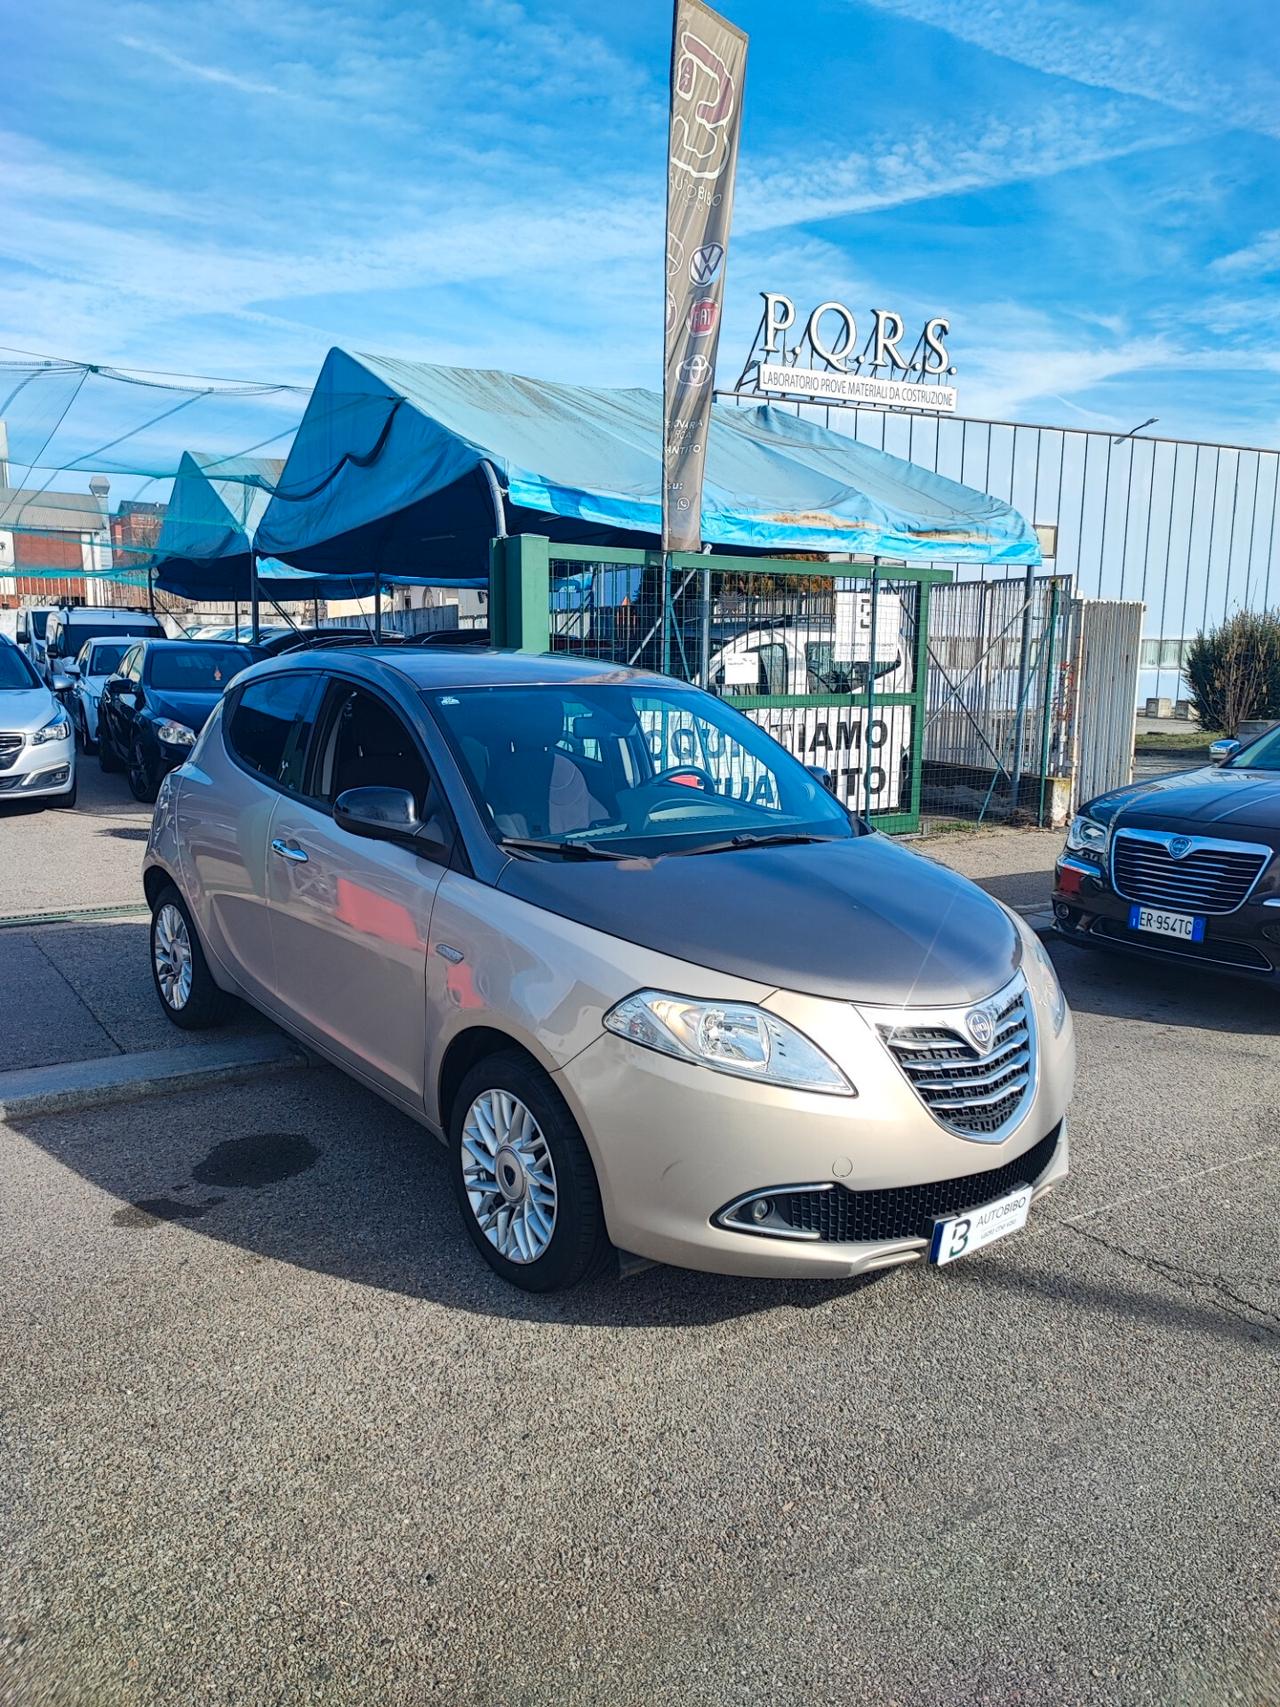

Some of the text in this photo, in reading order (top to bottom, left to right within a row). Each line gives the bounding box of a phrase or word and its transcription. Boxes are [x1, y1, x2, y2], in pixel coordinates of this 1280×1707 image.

[763, 371, 953, 407] LABORATORIO PROVE MATERIALI DA COSTRUZIONE
[976, 1196, 1027, 1229] AUTOBIBO
